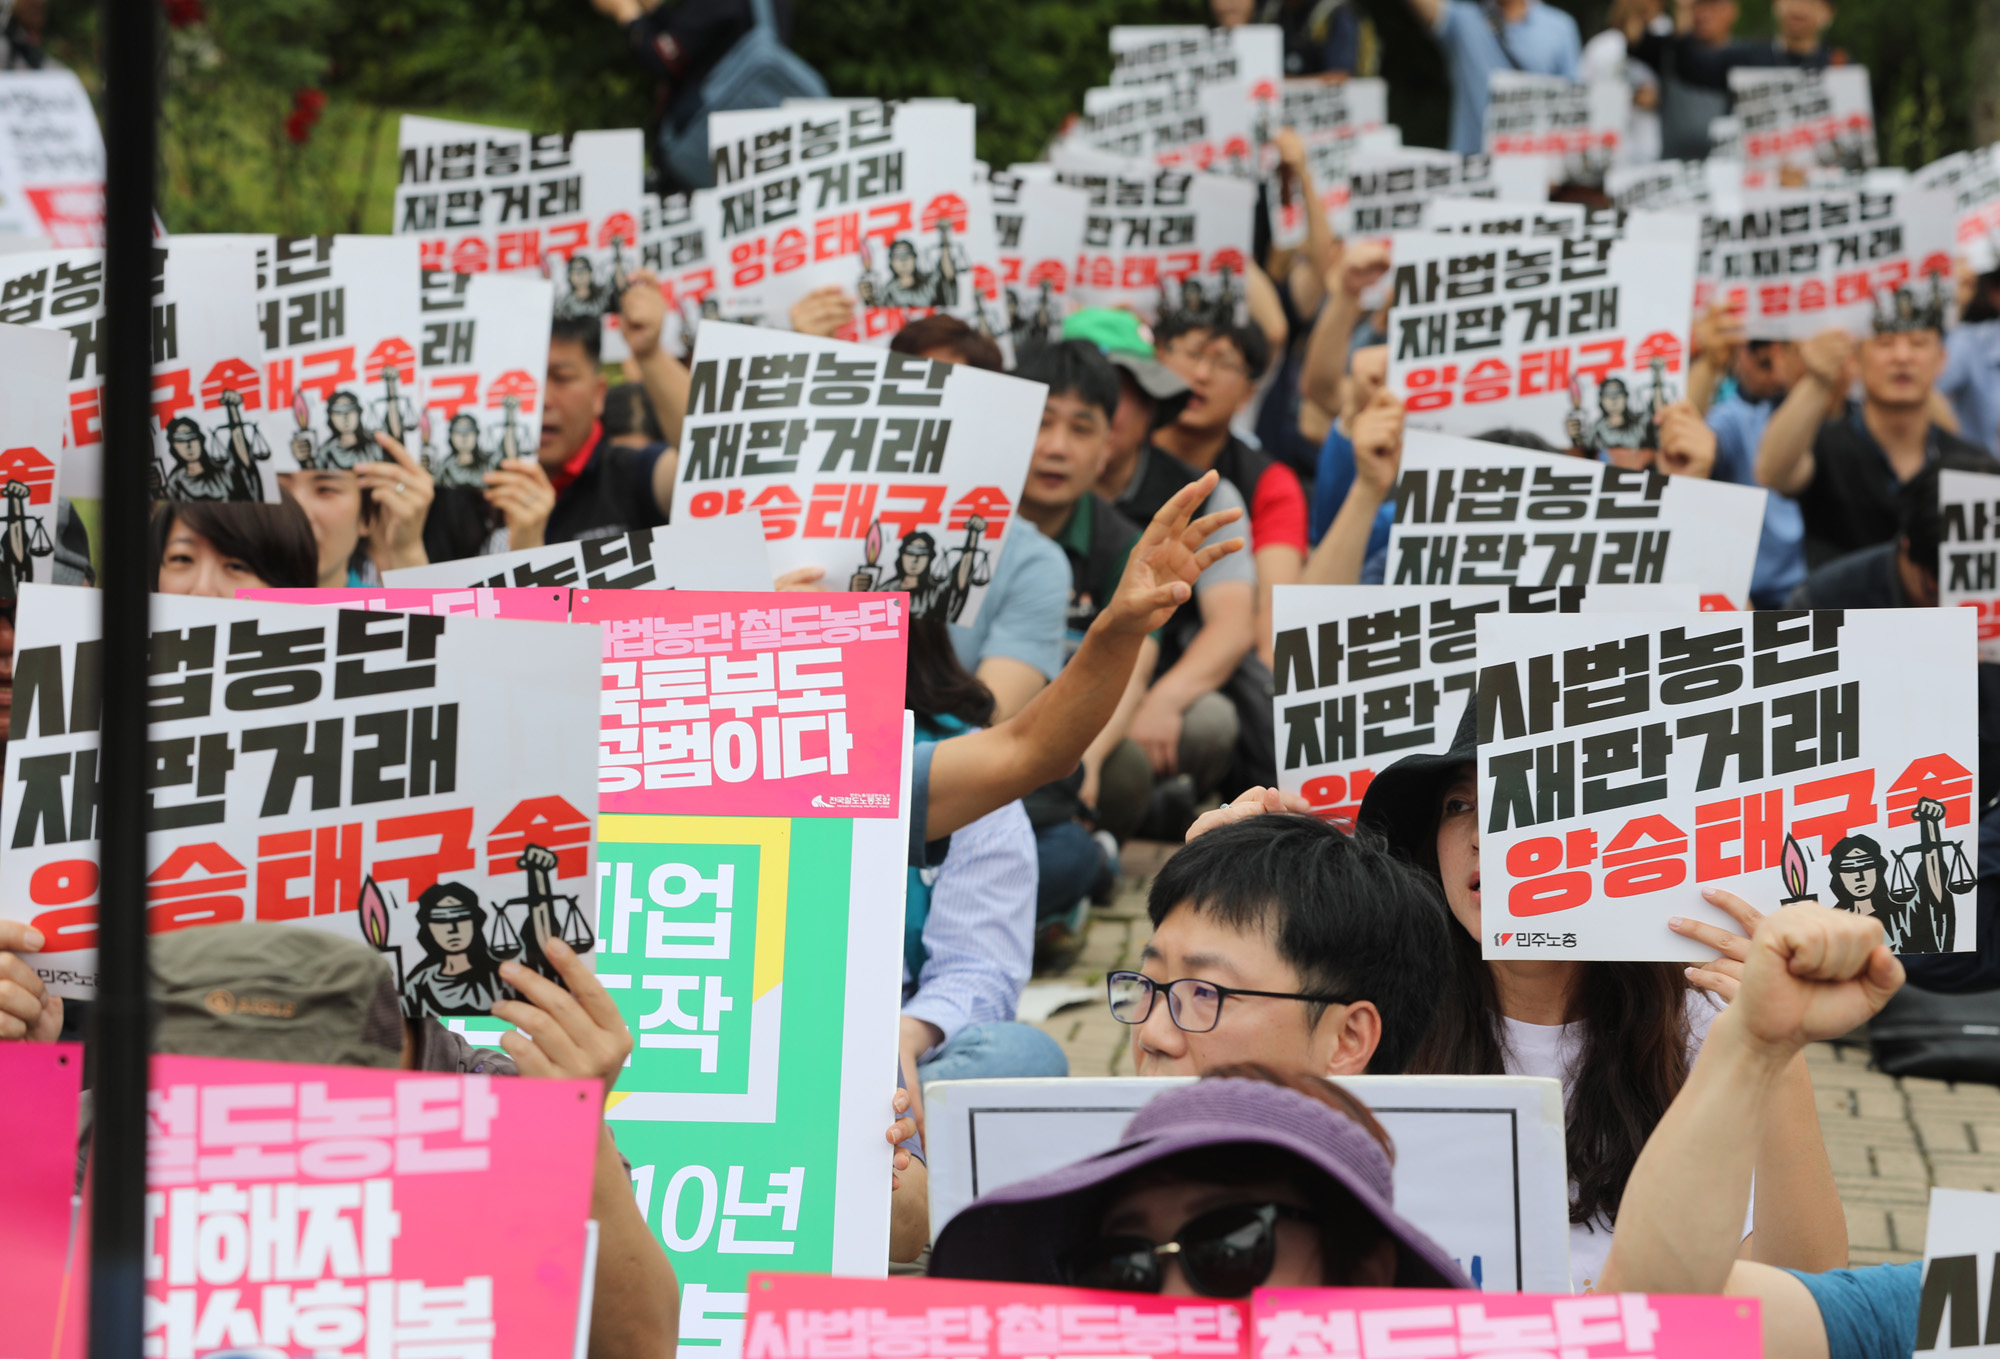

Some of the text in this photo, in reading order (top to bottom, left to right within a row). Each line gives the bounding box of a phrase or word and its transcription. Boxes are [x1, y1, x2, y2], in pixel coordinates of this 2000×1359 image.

[714, 100, 897, 188] 사법농단
[721, 151, 903, 240] 재판거래
[1086, 214, 1196, 246] 판거래
[1395, 238, 1614, 307] 사법농단
[1397, 285, 1618, 362] 재판거래
[686, 352, 953, 416] 사법농단
[682, 417, 953, 483] 재판거래
[1394, 465, 1670, 524] 사법농단
[1393, 530, 1671, 585] 재판거래
[739, 598, 901, 650] 철도농단
[1477, 610, 1844, 745] 사법농단
[1488, 680, 1860, 833] 재판거래
[1516, 932, 1577, 948] 민주노총
[37, 968, 99, 987] 민주노
[746, 1305, 992, 1358] 사법농단
[997, 1303, 1242, 1356] 철도농단
